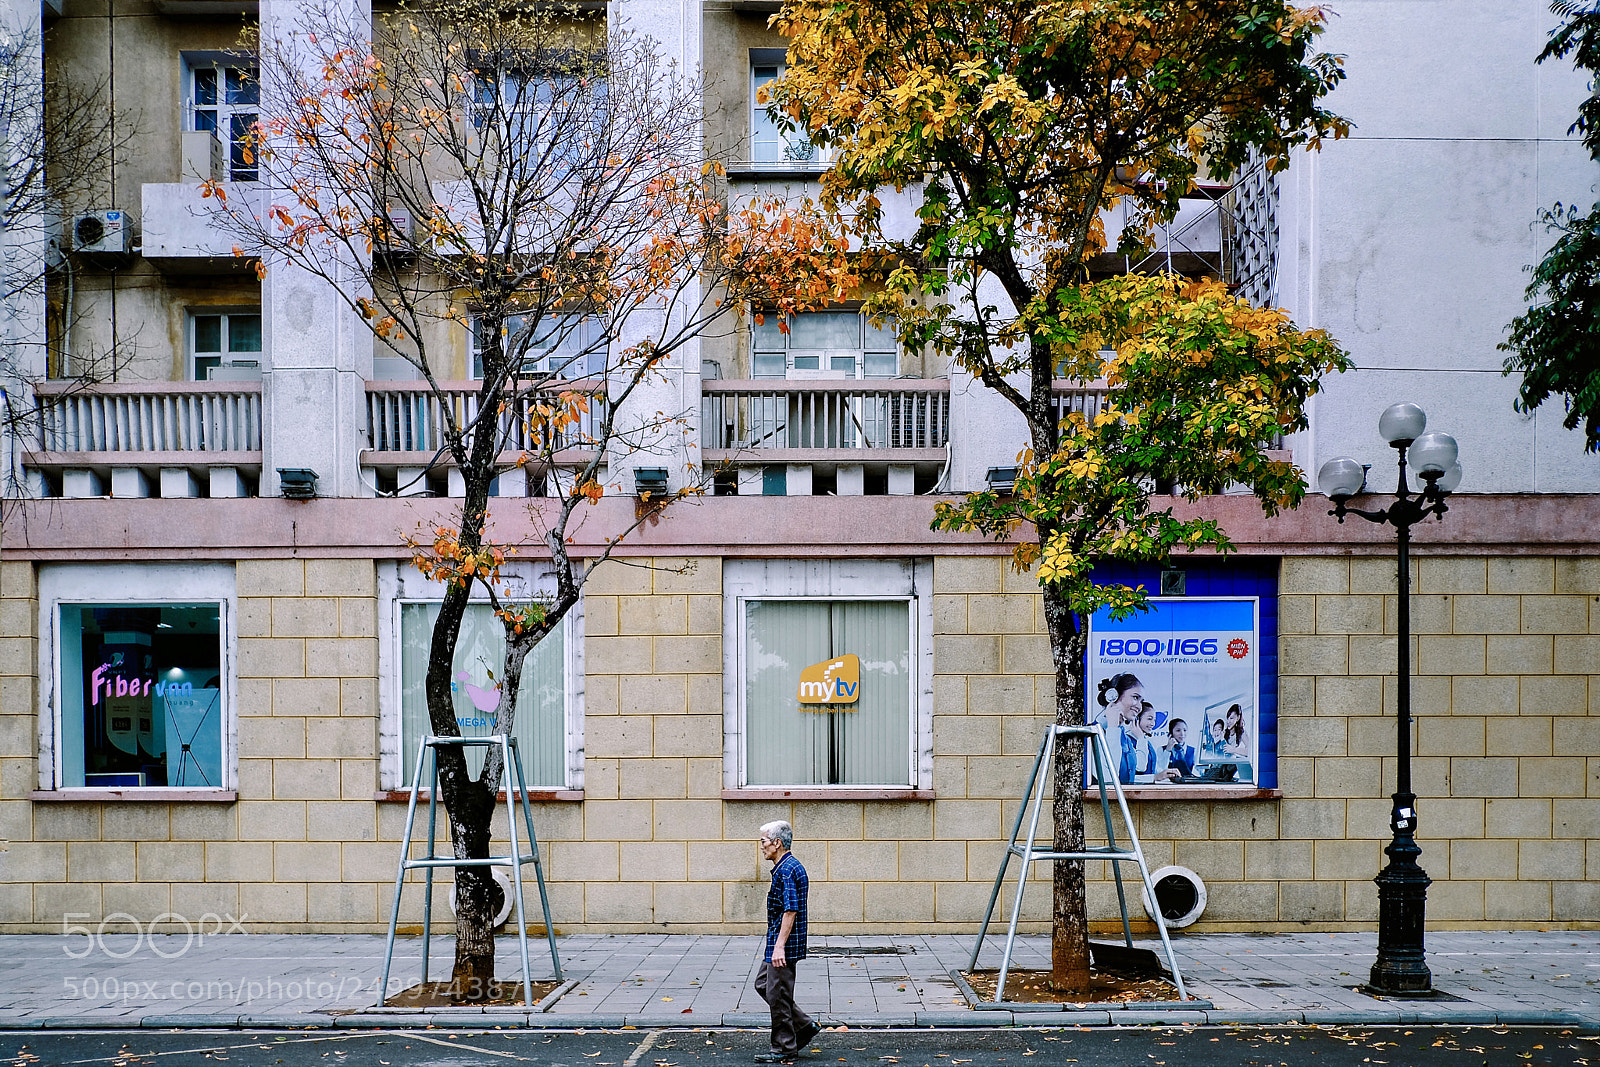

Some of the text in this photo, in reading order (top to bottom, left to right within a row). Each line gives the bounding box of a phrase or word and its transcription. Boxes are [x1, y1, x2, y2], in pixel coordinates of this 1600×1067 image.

[1099, 639, 1218, 656] 1800 1166
[800, 677, 858, 702] mytv
[456, 717, 487, 727] MEGA
